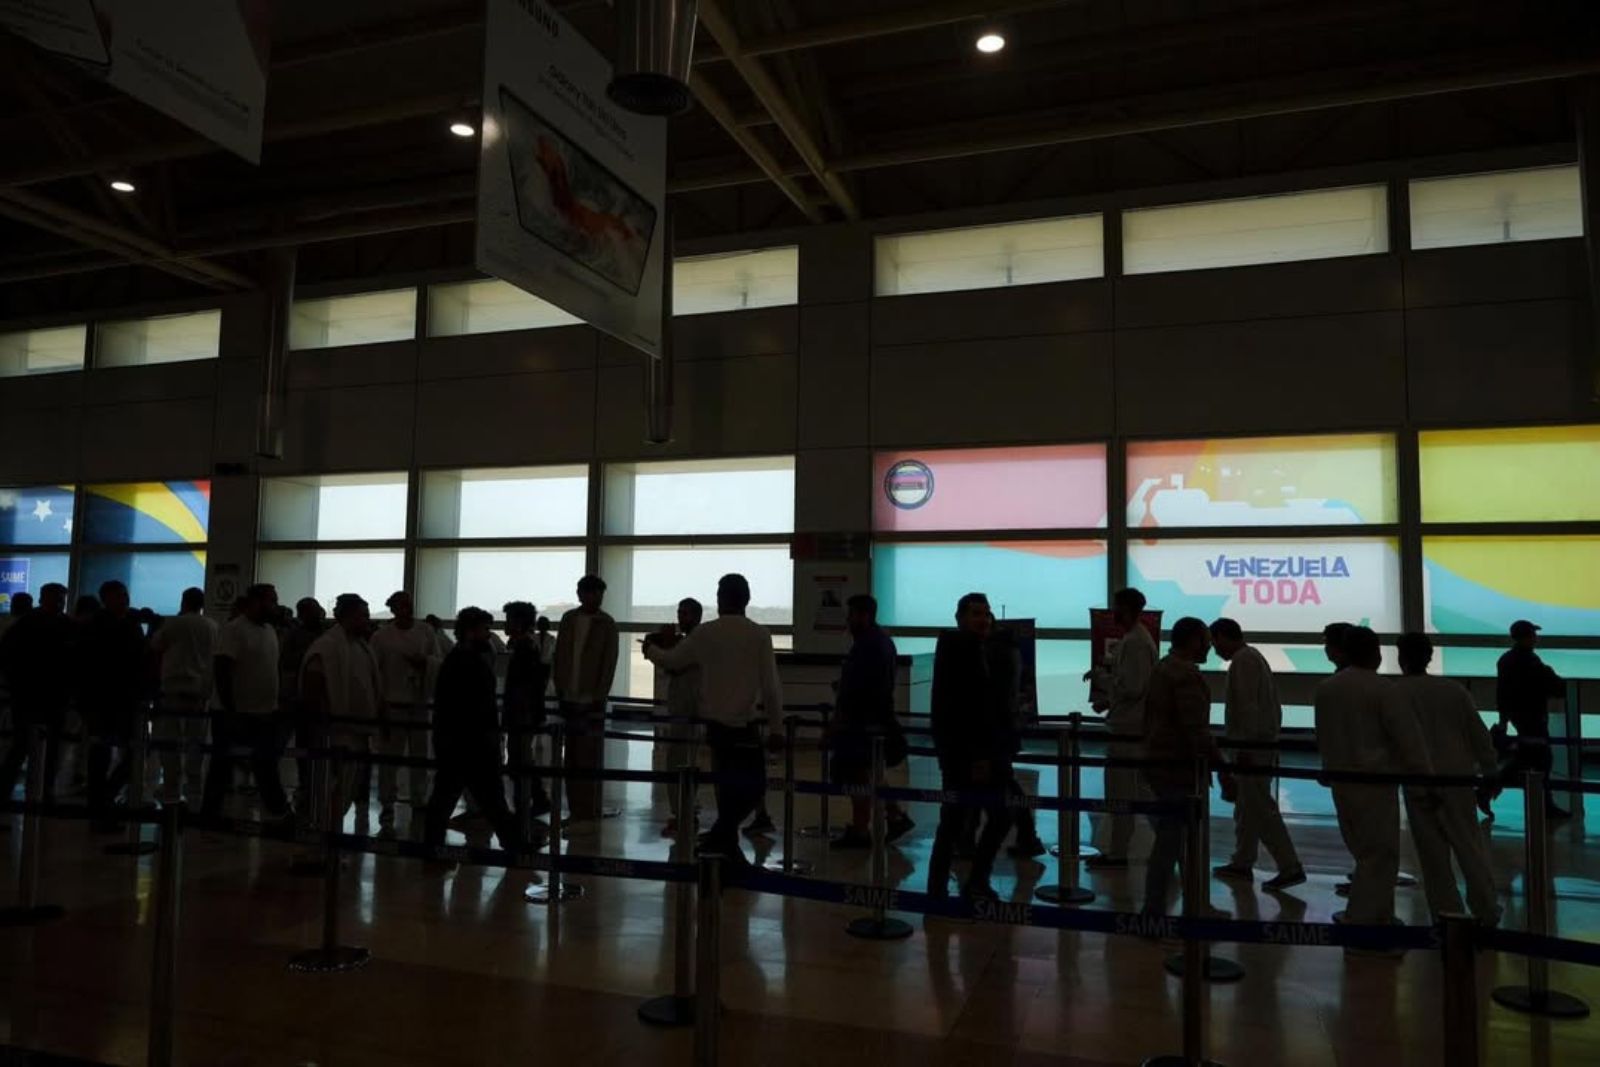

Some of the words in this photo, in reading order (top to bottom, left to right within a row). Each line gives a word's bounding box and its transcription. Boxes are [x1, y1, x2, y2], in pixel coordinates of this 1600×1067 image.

[1206, 555, 1350, 577] VENEZUELA
[1232, 579, 1321, 605] TODA
[843, 886, 899, 910] SAIME
[973, 900, 1033, 925] SAIME
[1115, 914, 1180, 938] SAIME
[1262, 924, 1330, 945] SAIME
